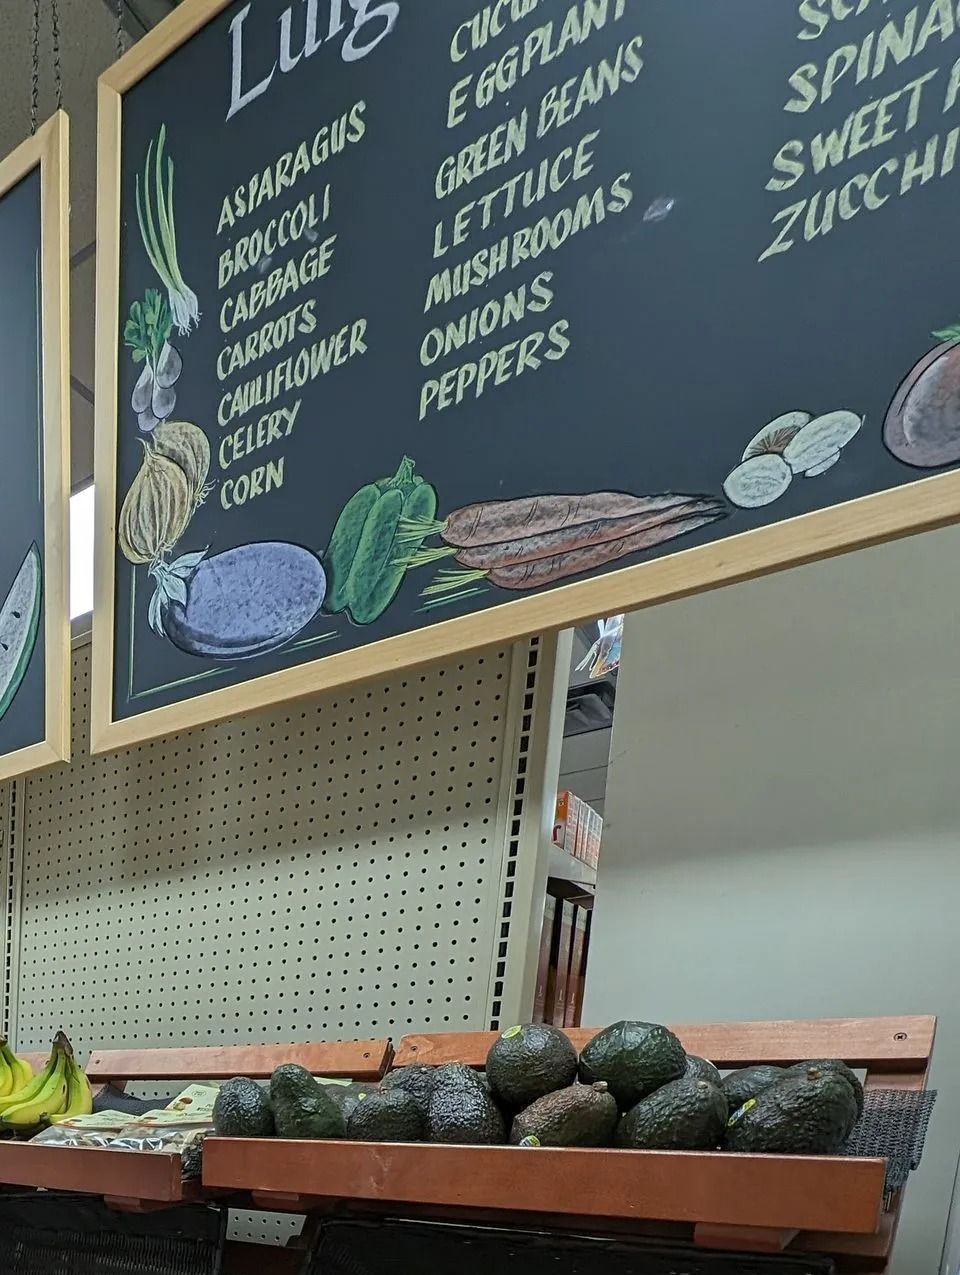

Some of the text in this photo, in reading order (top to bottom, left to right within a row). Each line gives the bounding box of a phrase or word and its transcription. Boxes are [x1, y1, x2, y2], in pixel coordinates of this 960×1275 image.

[783, 0, 960, 113] SPINA
[216, 100, 367, 235] ASPARAGUS
[435, 34, 644, 200] GREEN BEANS
[764, 67, 940, 192] SWEET
[218, 183, 331, 290] BROCCOLI
[423, 172, 633, 314] MUSHROOMS
[433, 129, 600, 258] LETTUCE
[219, 233, 338, 333] CABBAGE
[420, 271, 554, 367] ONIONS
[216, 299, 318, 381] CARROTS
[217, 318, 368, 427] CAULIFLOWER
[419, 319, 571, 421] PEPPERS
[218, 398, 302, 470] CELERY
[220, 456, 284, 510] CORN
